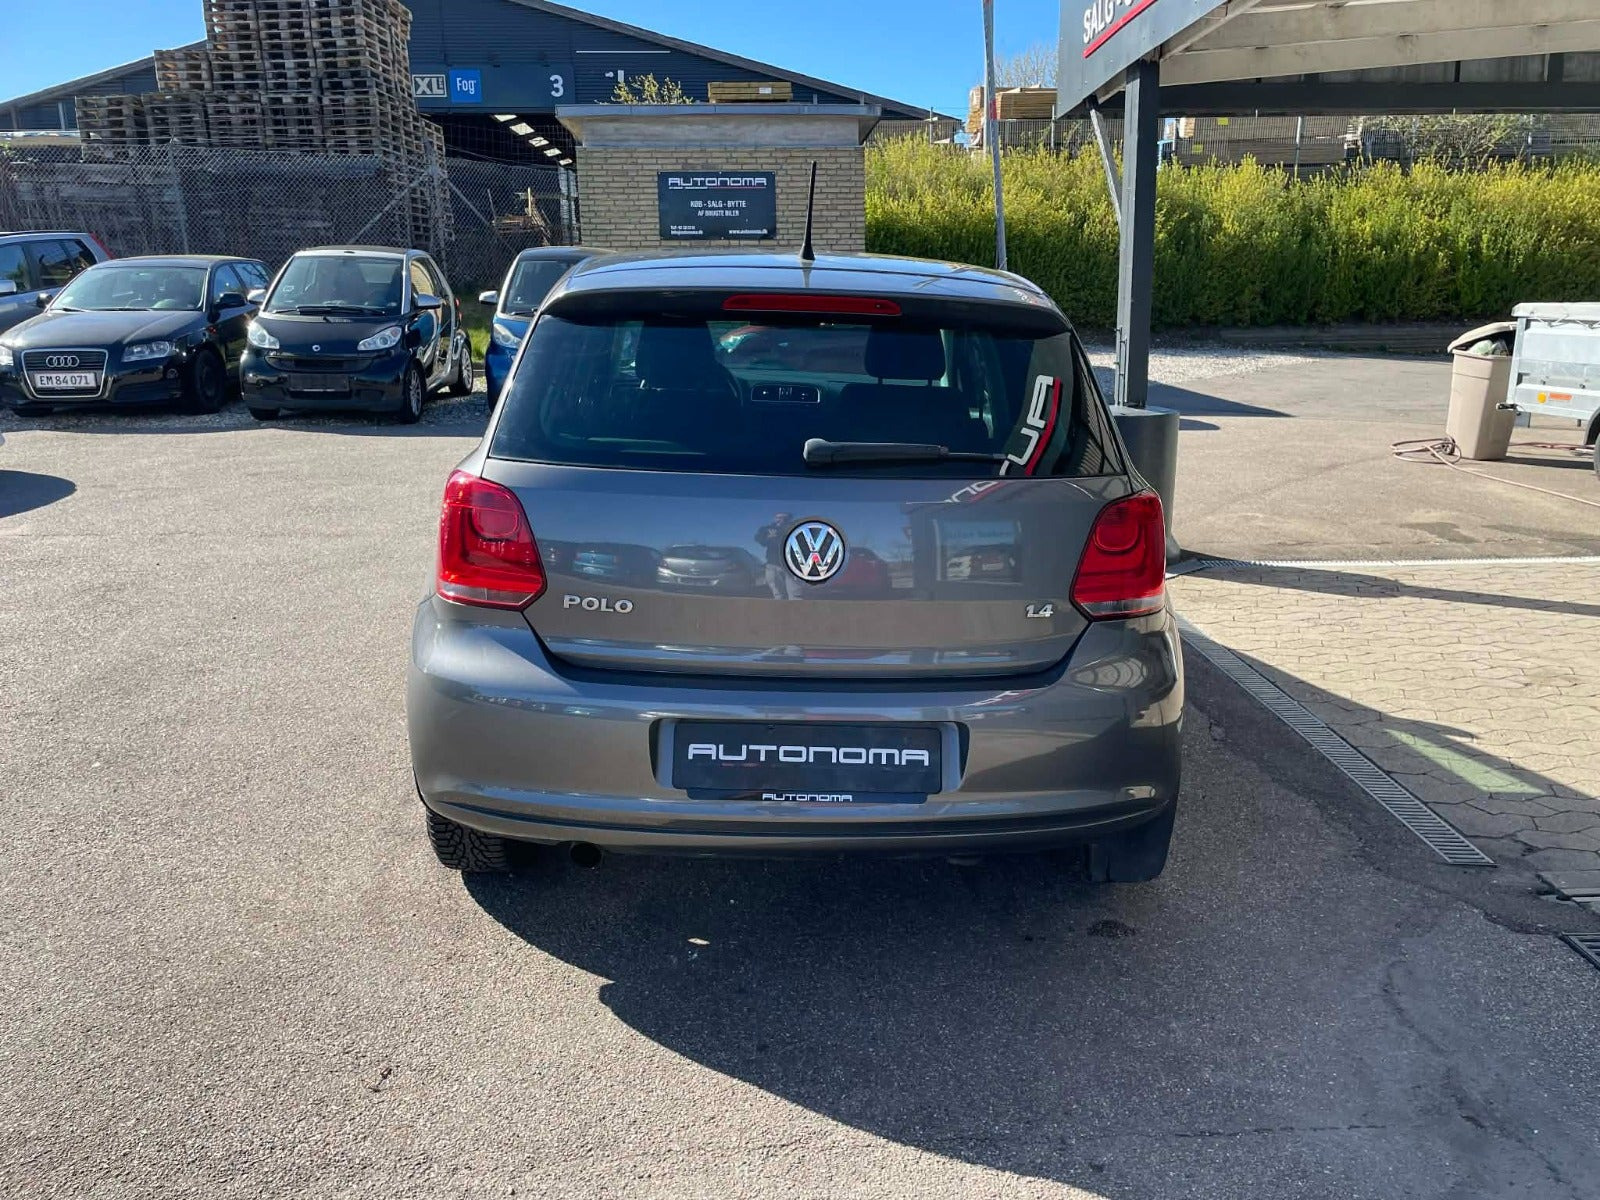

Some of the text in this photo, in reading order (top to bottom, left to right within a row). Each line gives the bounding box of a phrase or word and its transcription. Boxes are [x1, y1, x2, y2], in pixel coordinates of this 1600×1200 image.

[1083, 0, 1115, 44] SALG
[456, 77, 476, 95] Fog
[550, 75, 564, 97] 3
[668, 177, 767, 186] AUTONOMA
[707, 200, 723, 208] SALG
[727, 200, 747, 208] BYTTE
[563, 594, 634, 614] POLO
[688, 743, 930, 766] AUTONOMA
[762, 793, 852, 802] AUTONOMA
